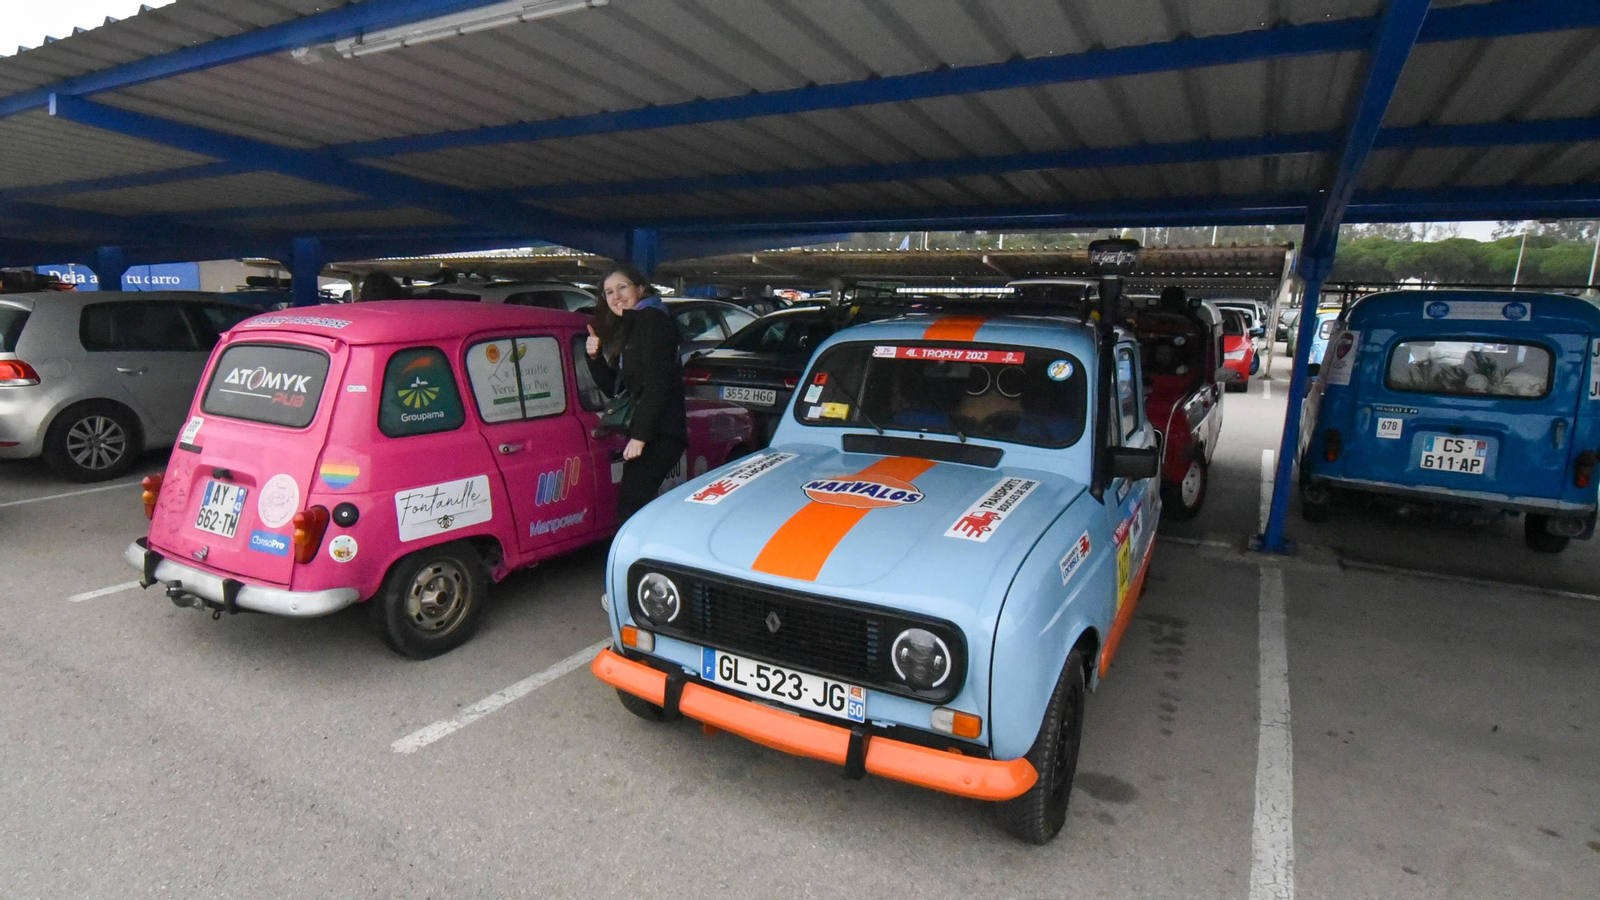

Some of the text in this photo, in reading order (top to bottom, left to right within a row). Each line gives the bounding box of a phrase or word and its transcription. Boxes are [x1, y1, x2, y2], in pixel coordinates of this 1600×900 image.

[126, 274, 141, 284] tu
[144, 275, 180, 284] carro
[905, 349, 918, 357] 4L
[922, 349, 963, 359] TROPHY
[965, 350, 989, 361] 2023
[224, 366, 312, 393] ATOMYK
[816, 374, 824, 383] F
[271, 392, 306, 408] PUB
[725, 387, 773, 403] 3552 HGG
[401, 410, 444, 422] Groupama
[1381, 420, 1398, 431] 678
[1424, 454, 1481, 472] 611-AP
[979, 478, 1022, 509] TRANSPORTS
[400, 480, 481, 526] Fontanille
[997, 494, 1020, 512] BOUCLES
[529, 515, 587, 537] Manpower
[252, 535, 286, 550] ConsoPro
[705, 666, 711, 674] F
[849, 702, 863, 718] 50
